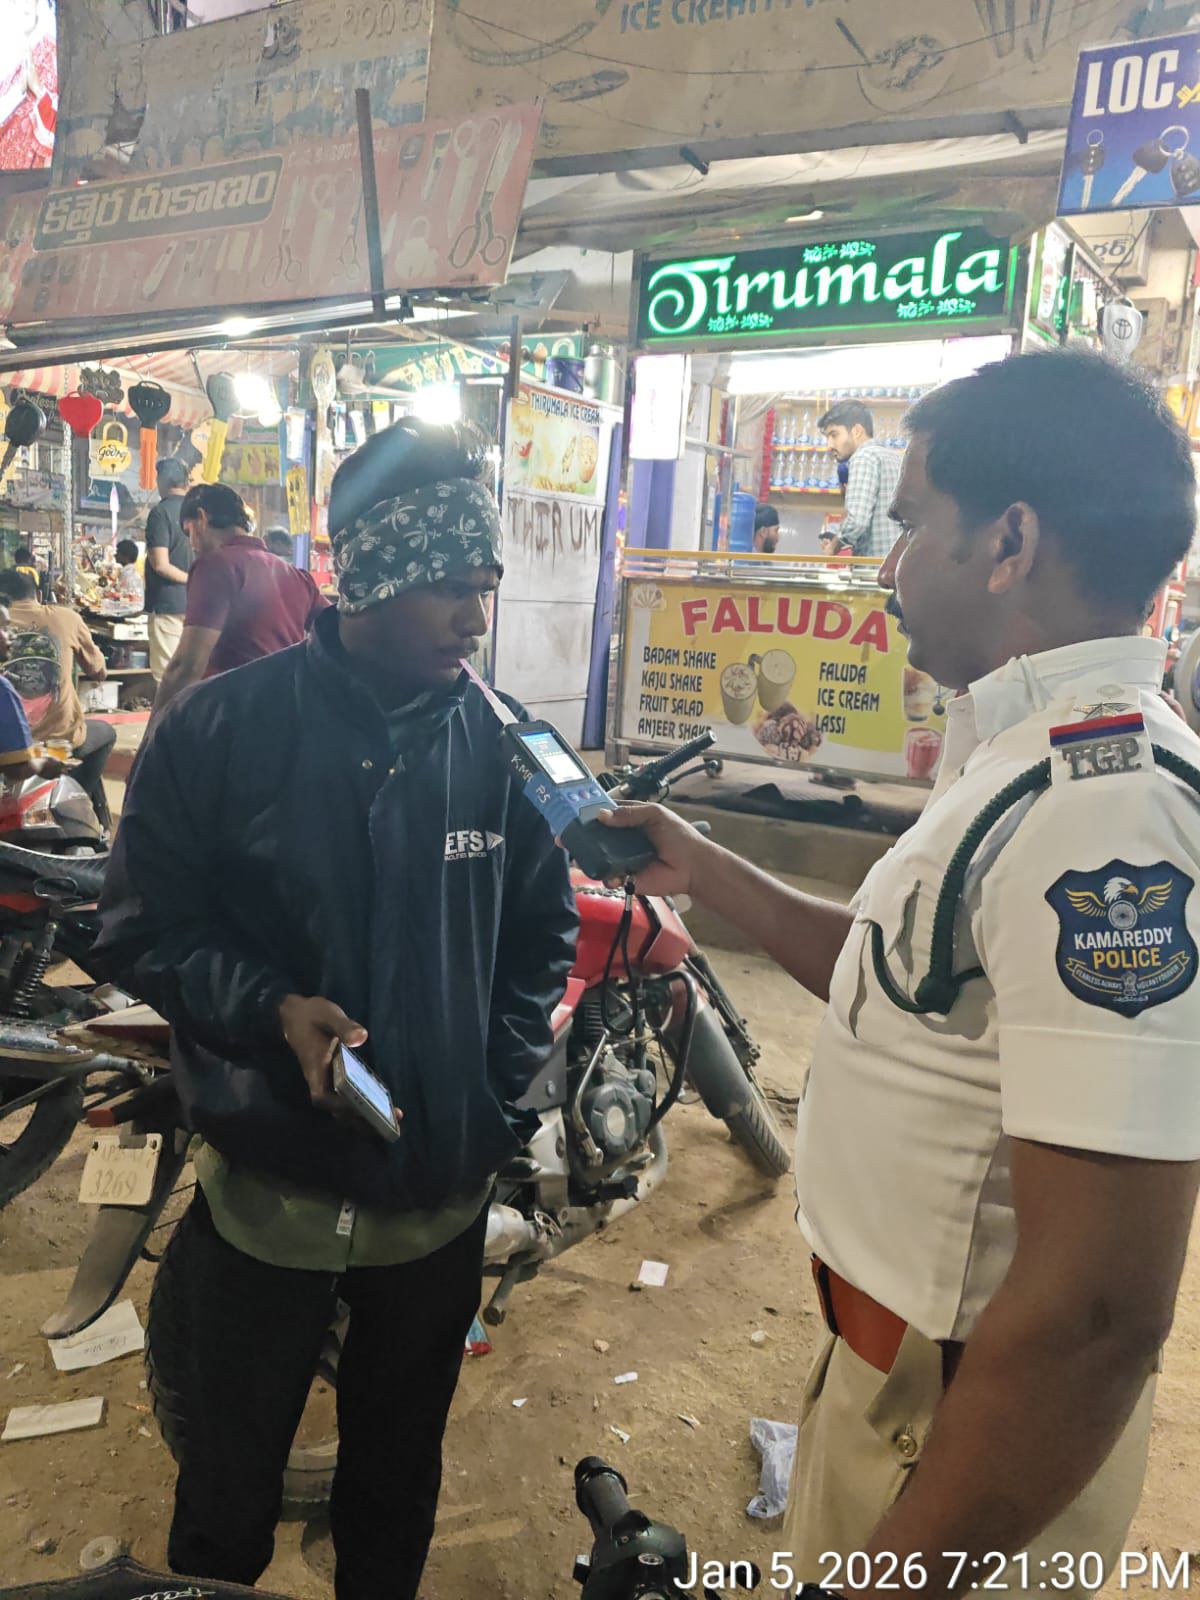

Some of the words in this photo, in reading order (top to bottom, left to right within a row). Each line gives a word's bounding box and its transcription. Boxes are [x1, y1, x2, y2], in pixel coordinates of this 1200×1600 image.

[1082, 48, 1200, 117] LOC
[648, 231, 1004, 335] Tirumala
[680, 595, 889, 653] FALUDA
[643, 646, 680, 667] BADAM
[683, 650, 717, 669] SHAKE
[641, 670, 667, 691] KAJU
[669, 672, 703, 692] SHAKE
[819, 662, 867, 685] FALUDA
[639, 694, 669, 714] FRUIT
[671, 698, 704, 716] SALAD
[817, 687, 835, 708] ICE
[838, 690, 880, 712] CREAM
[638, 717, 676, 740] ANJEER
[815, 714, 846, 735] LASSI
[444, 830, 485, 855] EFS
[1074, 927, 1173, 950] KAMAREDDY
[1092, 947, 1162, 969] POLICE
